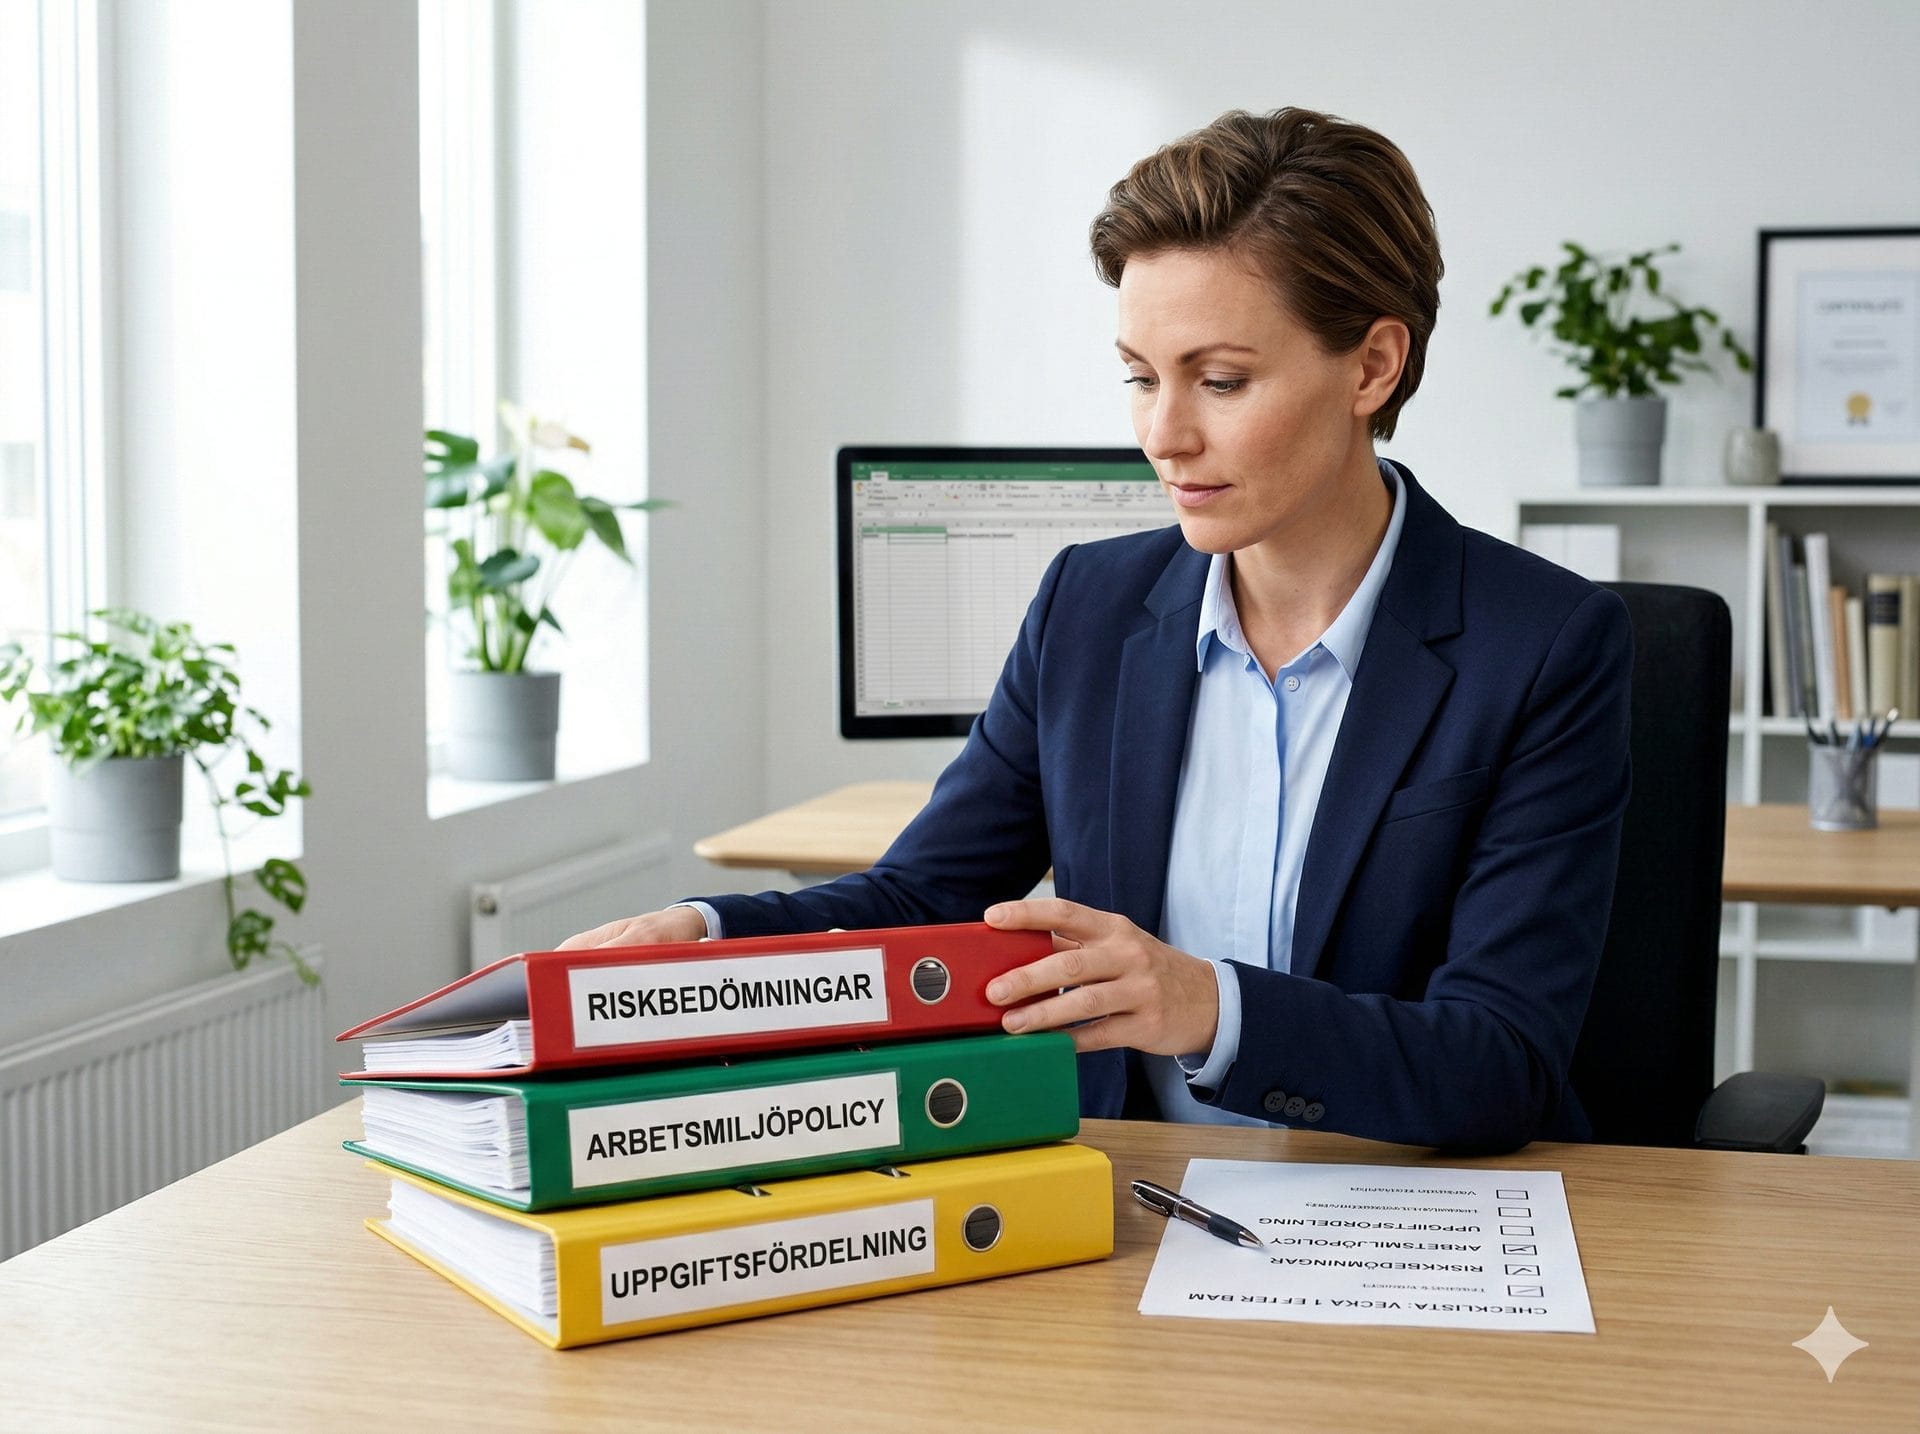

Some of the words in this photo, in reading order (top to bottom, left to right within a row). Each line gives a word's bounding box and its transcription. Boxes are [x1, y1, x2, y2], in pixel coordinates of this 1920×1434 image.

[588, 973, 873, 1021] RISKBEDÖMNINGAR
[586, 1098, 885, 1161] ARBETSMILJÖPOLICY
[1269, 1236, 1482, 1252] ARBETSMILJÖPOLICY
[611, 1226, 927, 1299] UPPGIFTSFÖRDELNING
[1187, 1293, 1235, 1303] BAM
[1240, 1295, 1307, 1306] EFTER
[1314, 1298, 1323, 1307] 1
[1330, 1299, 1402, 1311] VECKA
[1407, 1302, 1548, 1316] CHECKLISTA:
